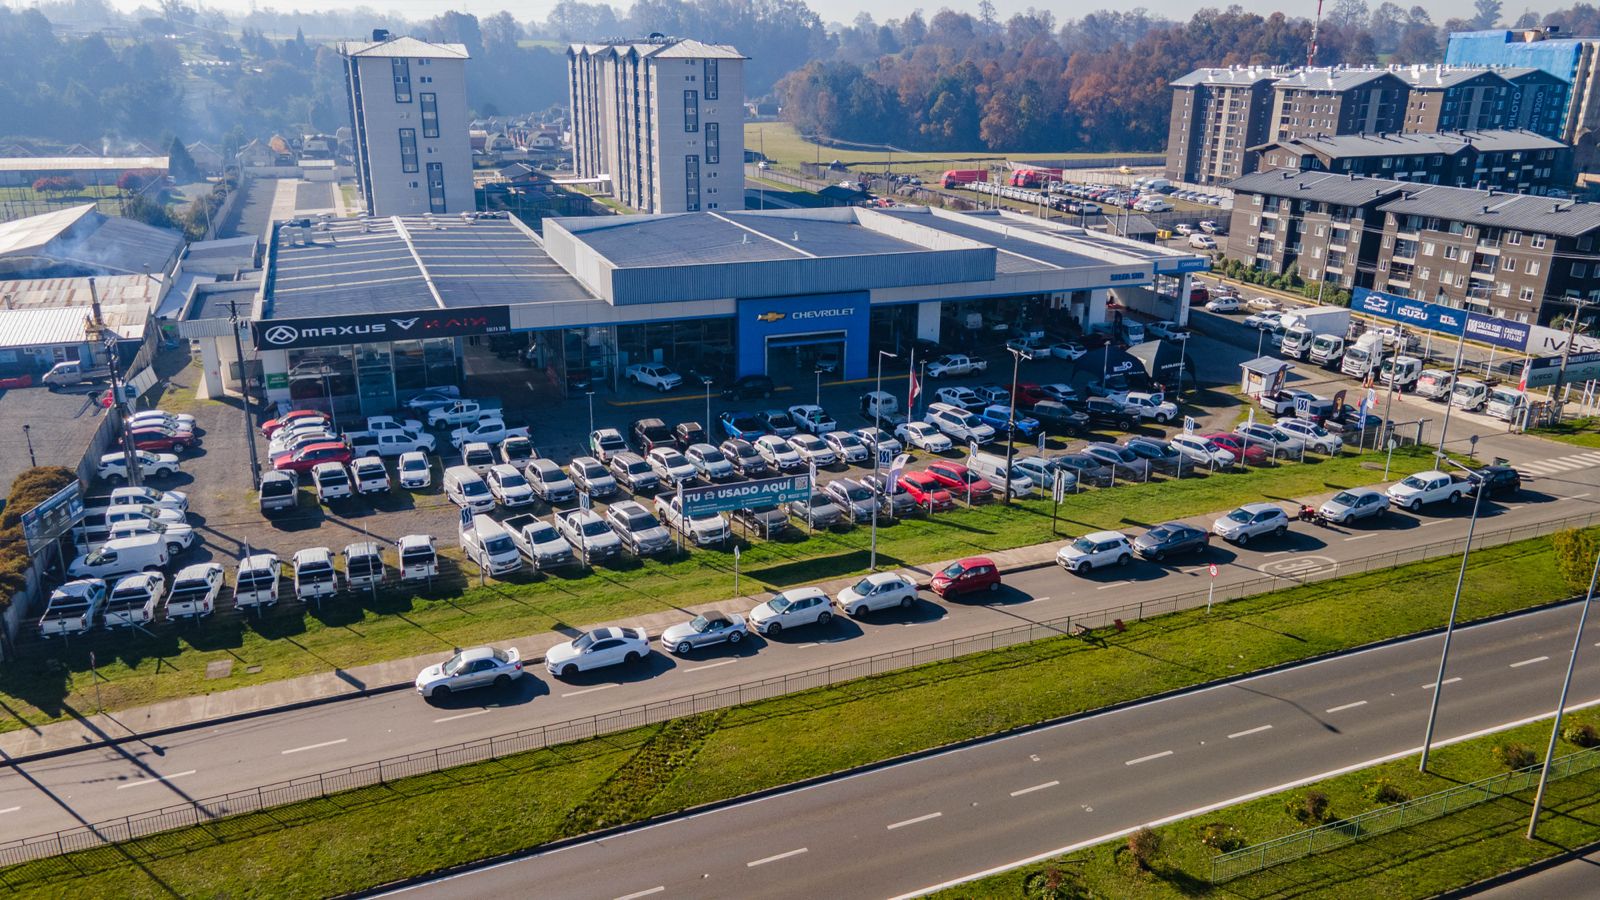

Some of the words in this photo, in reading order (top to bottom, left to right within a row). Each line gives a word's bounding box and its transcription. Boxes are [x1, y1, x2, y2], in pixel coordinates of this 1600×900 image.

[1508, 92, 1521, 127] PILOTO
[792, 307, 855, 320] CHEVROLET
[1397, 307, 1429, 320] ISUZU
[301, 323, 387, 338] MAXUS
[1543, 337, 1600, 353] IVEC
[685, 493, 701, 503] TU
[717, 486, 759, 498] USADO
[762, 479, 791, 493] AQUÍ
